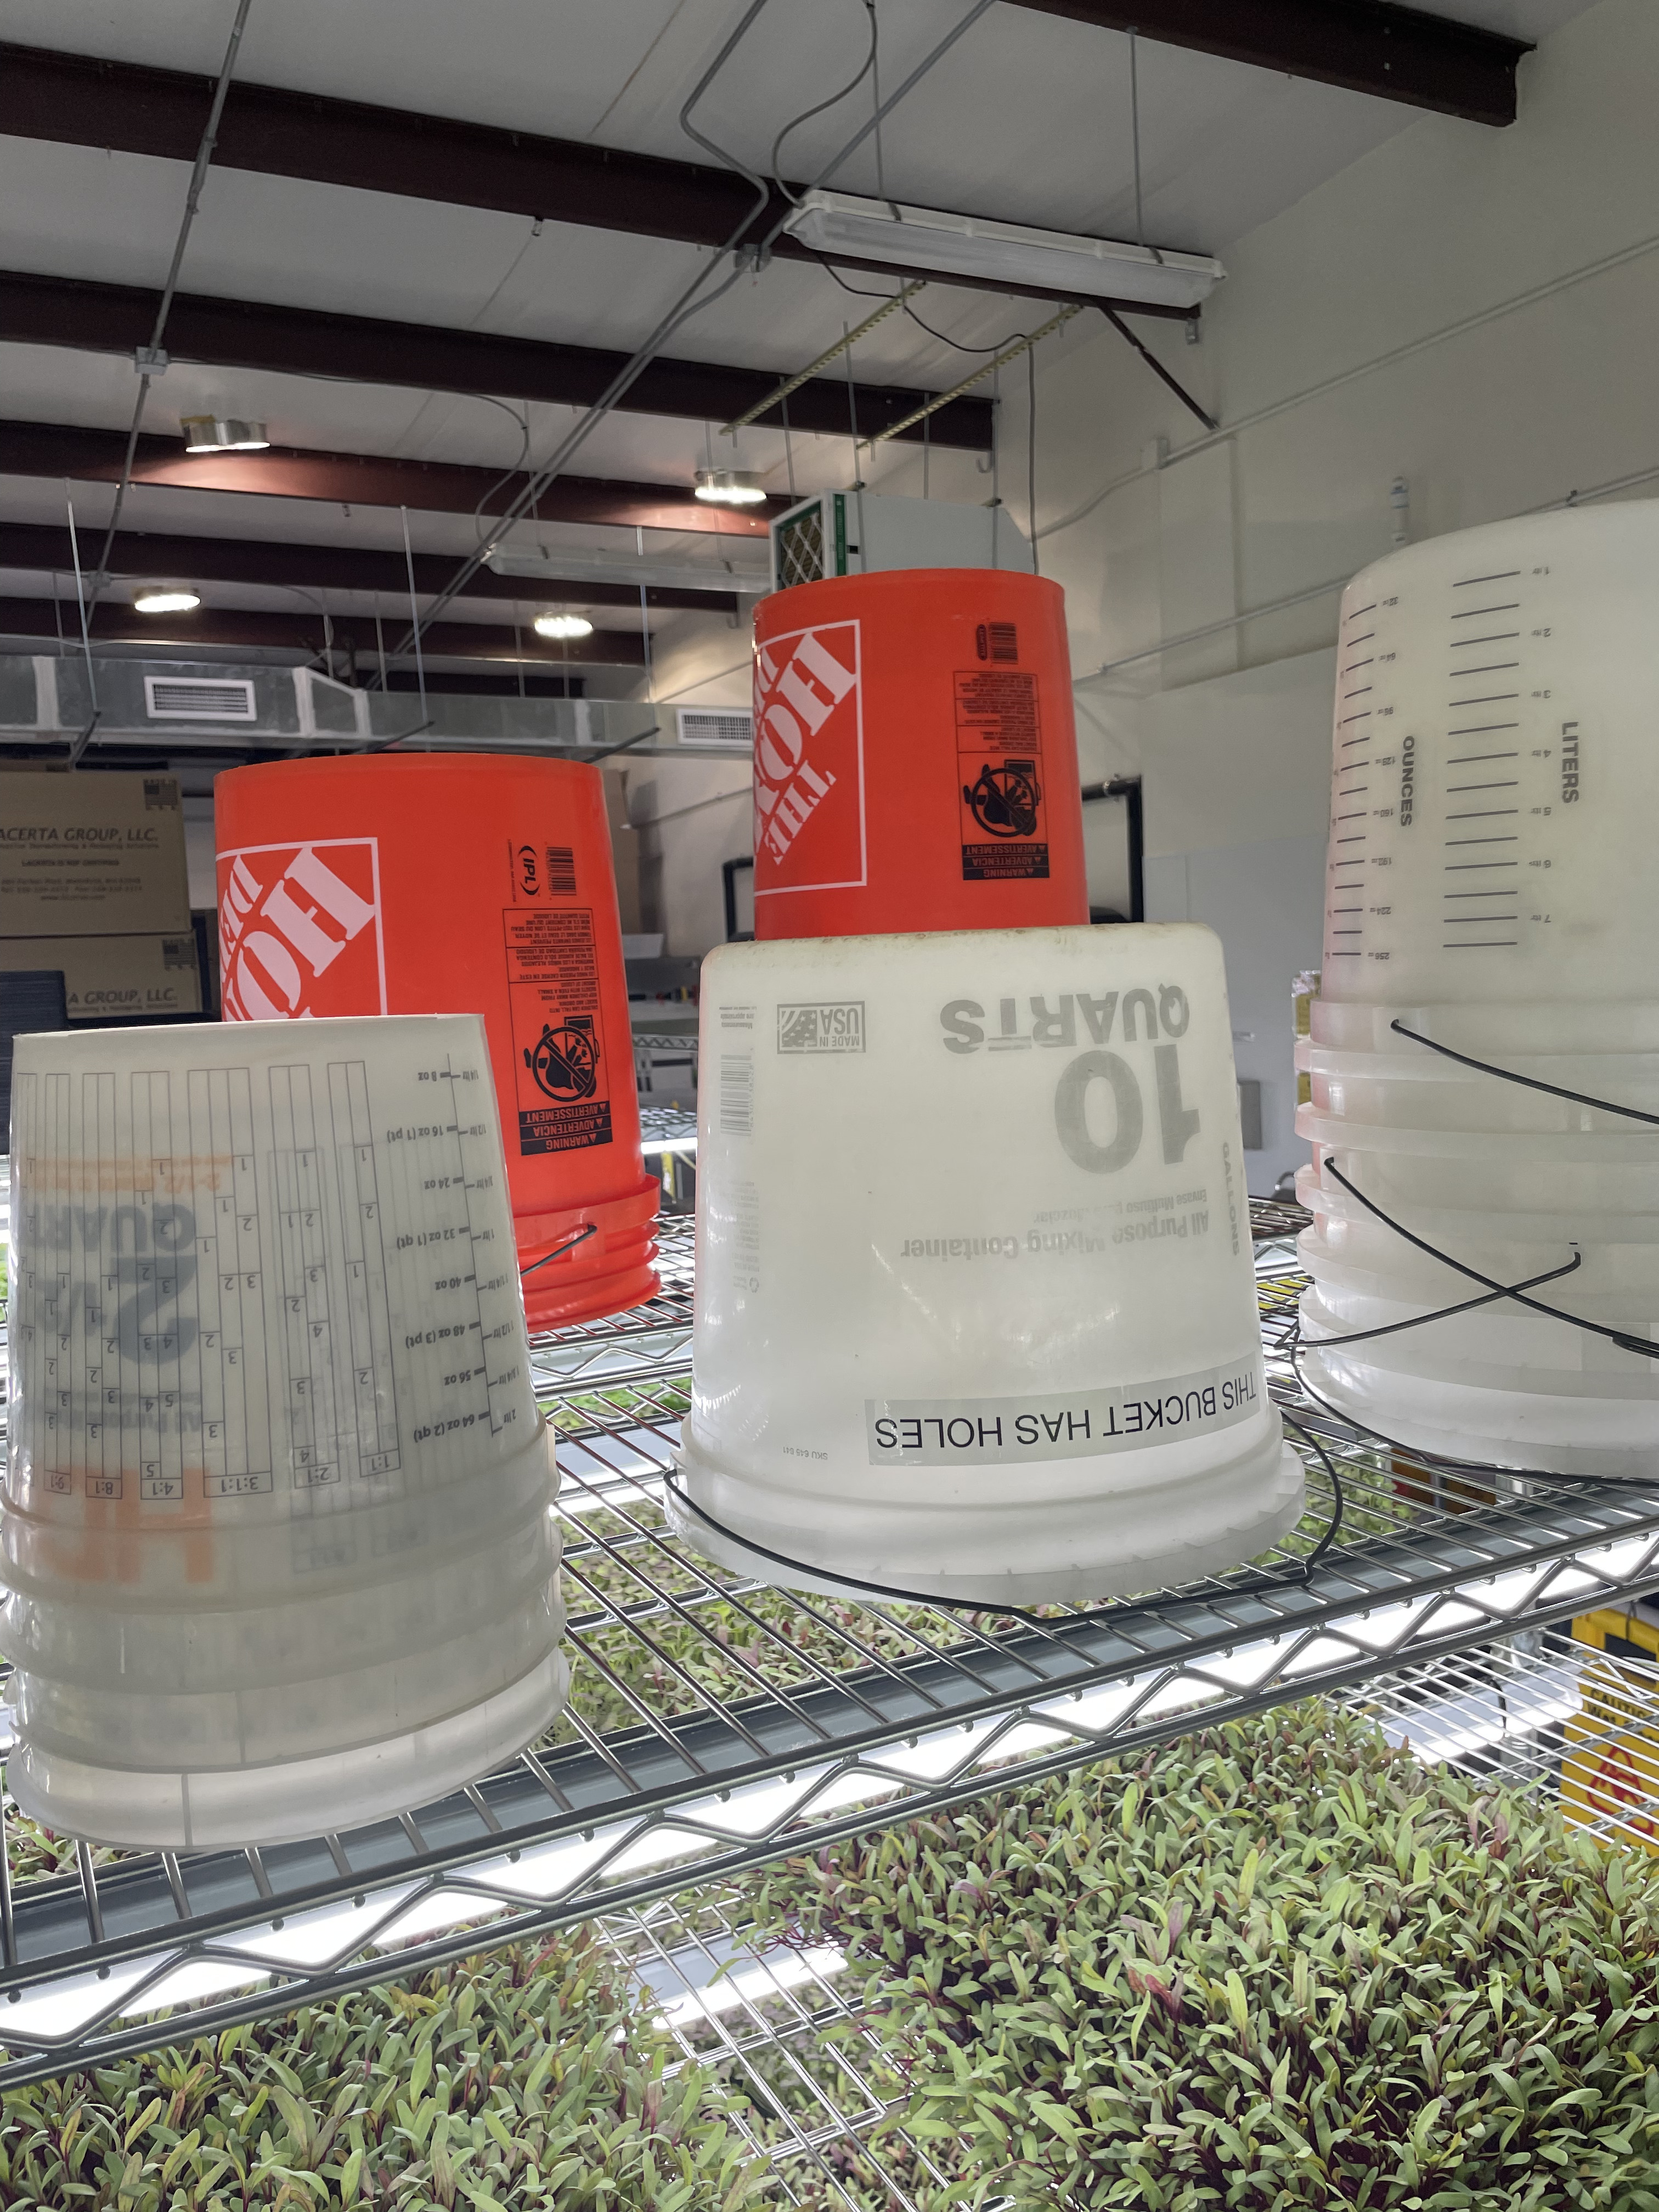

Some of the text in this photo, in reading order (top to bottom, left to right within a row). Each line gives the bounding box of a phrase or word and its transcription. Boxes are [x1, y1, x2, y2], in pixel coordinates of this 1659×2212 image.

[1561, 721, 1578, 803] LITERS
[1400, 736, 1414, 827] OUNCES
[966, 845, 1037, 854] AVERTISSEMENT
[972, 857, 1032, 866] ADVERTENCIA
[523, 858, 536, 884] IPL
[983, 868, 1026, 877] WARNING
[820, 1008, 859, 1035] USA
[940, 983, 1190, 1054] QUARTS
[820, 1036, 860, 1047] MADE IN
[417, 1072, 437, 1081] 8 oz
[525, 1104, 599, 1123] AVERTISSEMENT
[1054, 1044, 1201, 1175] 10
[386, 1126, 443, 1143] 16 oz (1 pt)
[533, 1120, 594, 1137] ADVERTENCIA
[545, 1135, 589, 1150] WARNING
[303, 1155, 308, 1167] 1
[362, 1149, 366, 1161] 1
[160, 1162, 164, 1175] 1
[241, 1158, 247, 1171] 1
[424, 1177, 450, 1189] 24 oz
[142, 1192, 146, 1205] 1
[1176, 1189, 1206, 1207] Envase
[1223, 1142, 1239, 1256] GALLONS
[223, 1200, 228, 1212] 1
[366, 1206, 374, 1219] 2
[243, 1218, 252, 1231] 2
[288, 1215, 293, 1227] 1
[306, 1214, 313, 1227] 2
[160, 1222, 167, 1234] 2
[396, 1229, 455, 1249] 32 oz (1 qt)
[900, 1210, 1209, 1261] All Purpose Mixing Container
[204, 1240, 209, 1252] 1
[142, 1267, 150, 1279] 2
[311, 1270, 318, 1282] 3
[353, 1266, 358, 1278] 1
[62, 1276, 66, 1288] 1
[108, 1278, 112, 1290] 1
[162, 1280, 170, 1293] 3
[225, 1277, 234, 1290] 2
[246, 1274, 256, 1287] 3
[435, 1277, 461, 1290] 40 oz
[292, 1300, 300, 1312] 2
[92, 1310, 95, 1322] 1
[313, 1326, 323, 1338] 4
[405, 1324, 465, 1348] 48 oz (3 pt)
[61, 1338, 67, 1350] 2
[108, 1341, 114, 1353] 2
[144, 1338, 151, 1350] 3
[164, 1337, 172, 1350] 4
[206, 1335, 214, 1347] 2
[228, 1351, 236, 1364] 3
[91, 1370, 97, 1383] 2
[359, 1372, 368, 1384] 2
[444, 1370, 471, 1385] 56 oz
[297, 1382, 305, 1394] 3
[61, 1394, 67, 1406] 3
[109, 1391, 115, 1403] 3
[166, 1395, 173, 1407] 5
[146, 1401, 154, 1412] 4
[875, 1372, 1256, 1448] THIS BUCKET HAS HOLES
[91, 1426, 97, 1438] 3
[209, 1425, 217, 1438] 3
[414, 1414, 475, 1442] 64 oz (2 qt)
[301, 1451, 308, 1462] 4
[811, 1451, 828, 1460] SKU
[371, 1455, 390, 1471] 1:1
[146, 1464, 154, 1477] 5
[307, 1468, 329, 1483] 2:1
[51, 1475, 64, 1490] 9:1
[95, 1482, 113, 1495] 8:1
[153, 1482, 173, 1496] 4:1
[221, 1476, 258, 1493] 3:1:1
